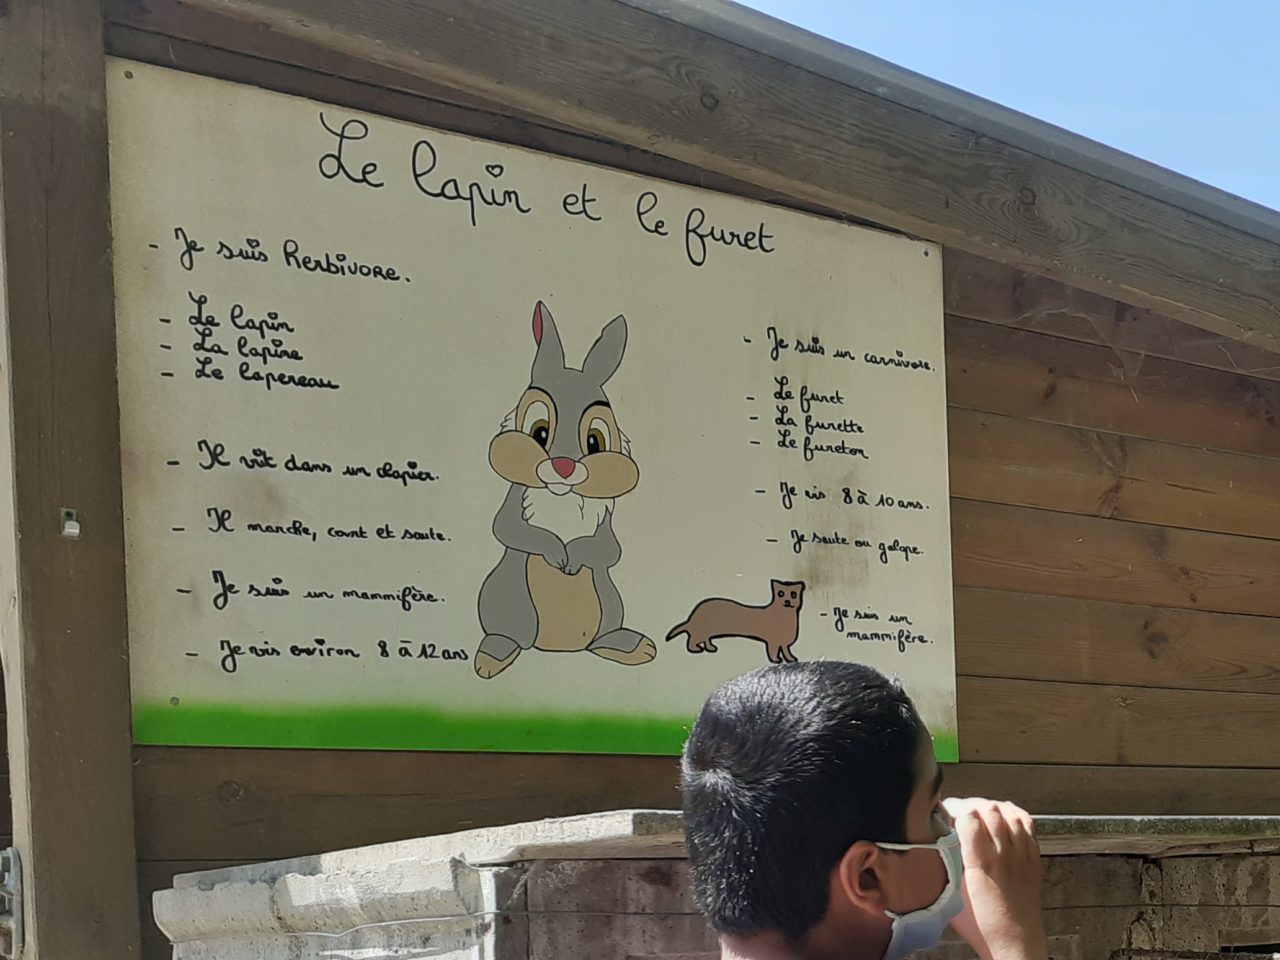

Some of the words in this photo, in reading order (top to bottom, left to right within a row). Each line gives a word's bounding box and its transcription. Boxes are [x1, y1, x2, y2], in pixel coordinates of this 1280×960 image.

[318, 111, 385, 187] Le
[411, 139, 532, 227] lapin
[562, 183, 602, 222] et
[636, 191, 669, 237] le
[685, 207, 775, 267] furet
[174, 226, 205, 272] Je
[216, 237, 269, 263] suis
[187, 290, 221, 328] Le
[230, 303, 295, 337] lapin
[192, 326, 229, 356] La
[237, 335, 304, 365] lapine
[766, 326, 790, 362] Je
[793, 335, 826, 356] suis
[832, 349, 856, 361] un
[194, 356, 225, 381] Le
[238, 361, 340, 391] lapereau
[773, 375, 795, 401] Le
[799, 385, 845, 414] furet
[774, 404, 798, 428] La
[804, 414, 865, 436] furette
[238, 447, 278, 470] vit
[283, 453, 333, 474] dans
[341, 465, 372, 478] un
[777, 428, 798, 449] Le
[803, 435, 869, 462] fureton
[779, 481, 798, 510] Je
[841, 486, 854, 505] 8
[856, 489, 870, 506] à
[874, 493, 895, 507] 10
[375, 523, 396, 540] et
[790, 529, 809, 554] Je
[811, 531, 850, 546] saute
[854, 539, 872, 548] ou
[211, 569, 241, 611] Je
[247, 576, 290, 598] suis
[302, 591, 335, 599] un
[833, 606, 850, 633] Je
[853, 605, 880, 621] suis
[888, 614, 913, 626] un
[219, 639, 246, 674] Je
[376, 639, 390, 658] 8
[398, 639, 413, 658] à
[416, 643, 441, 660] 12
[441, 648, 469, 661] ans
